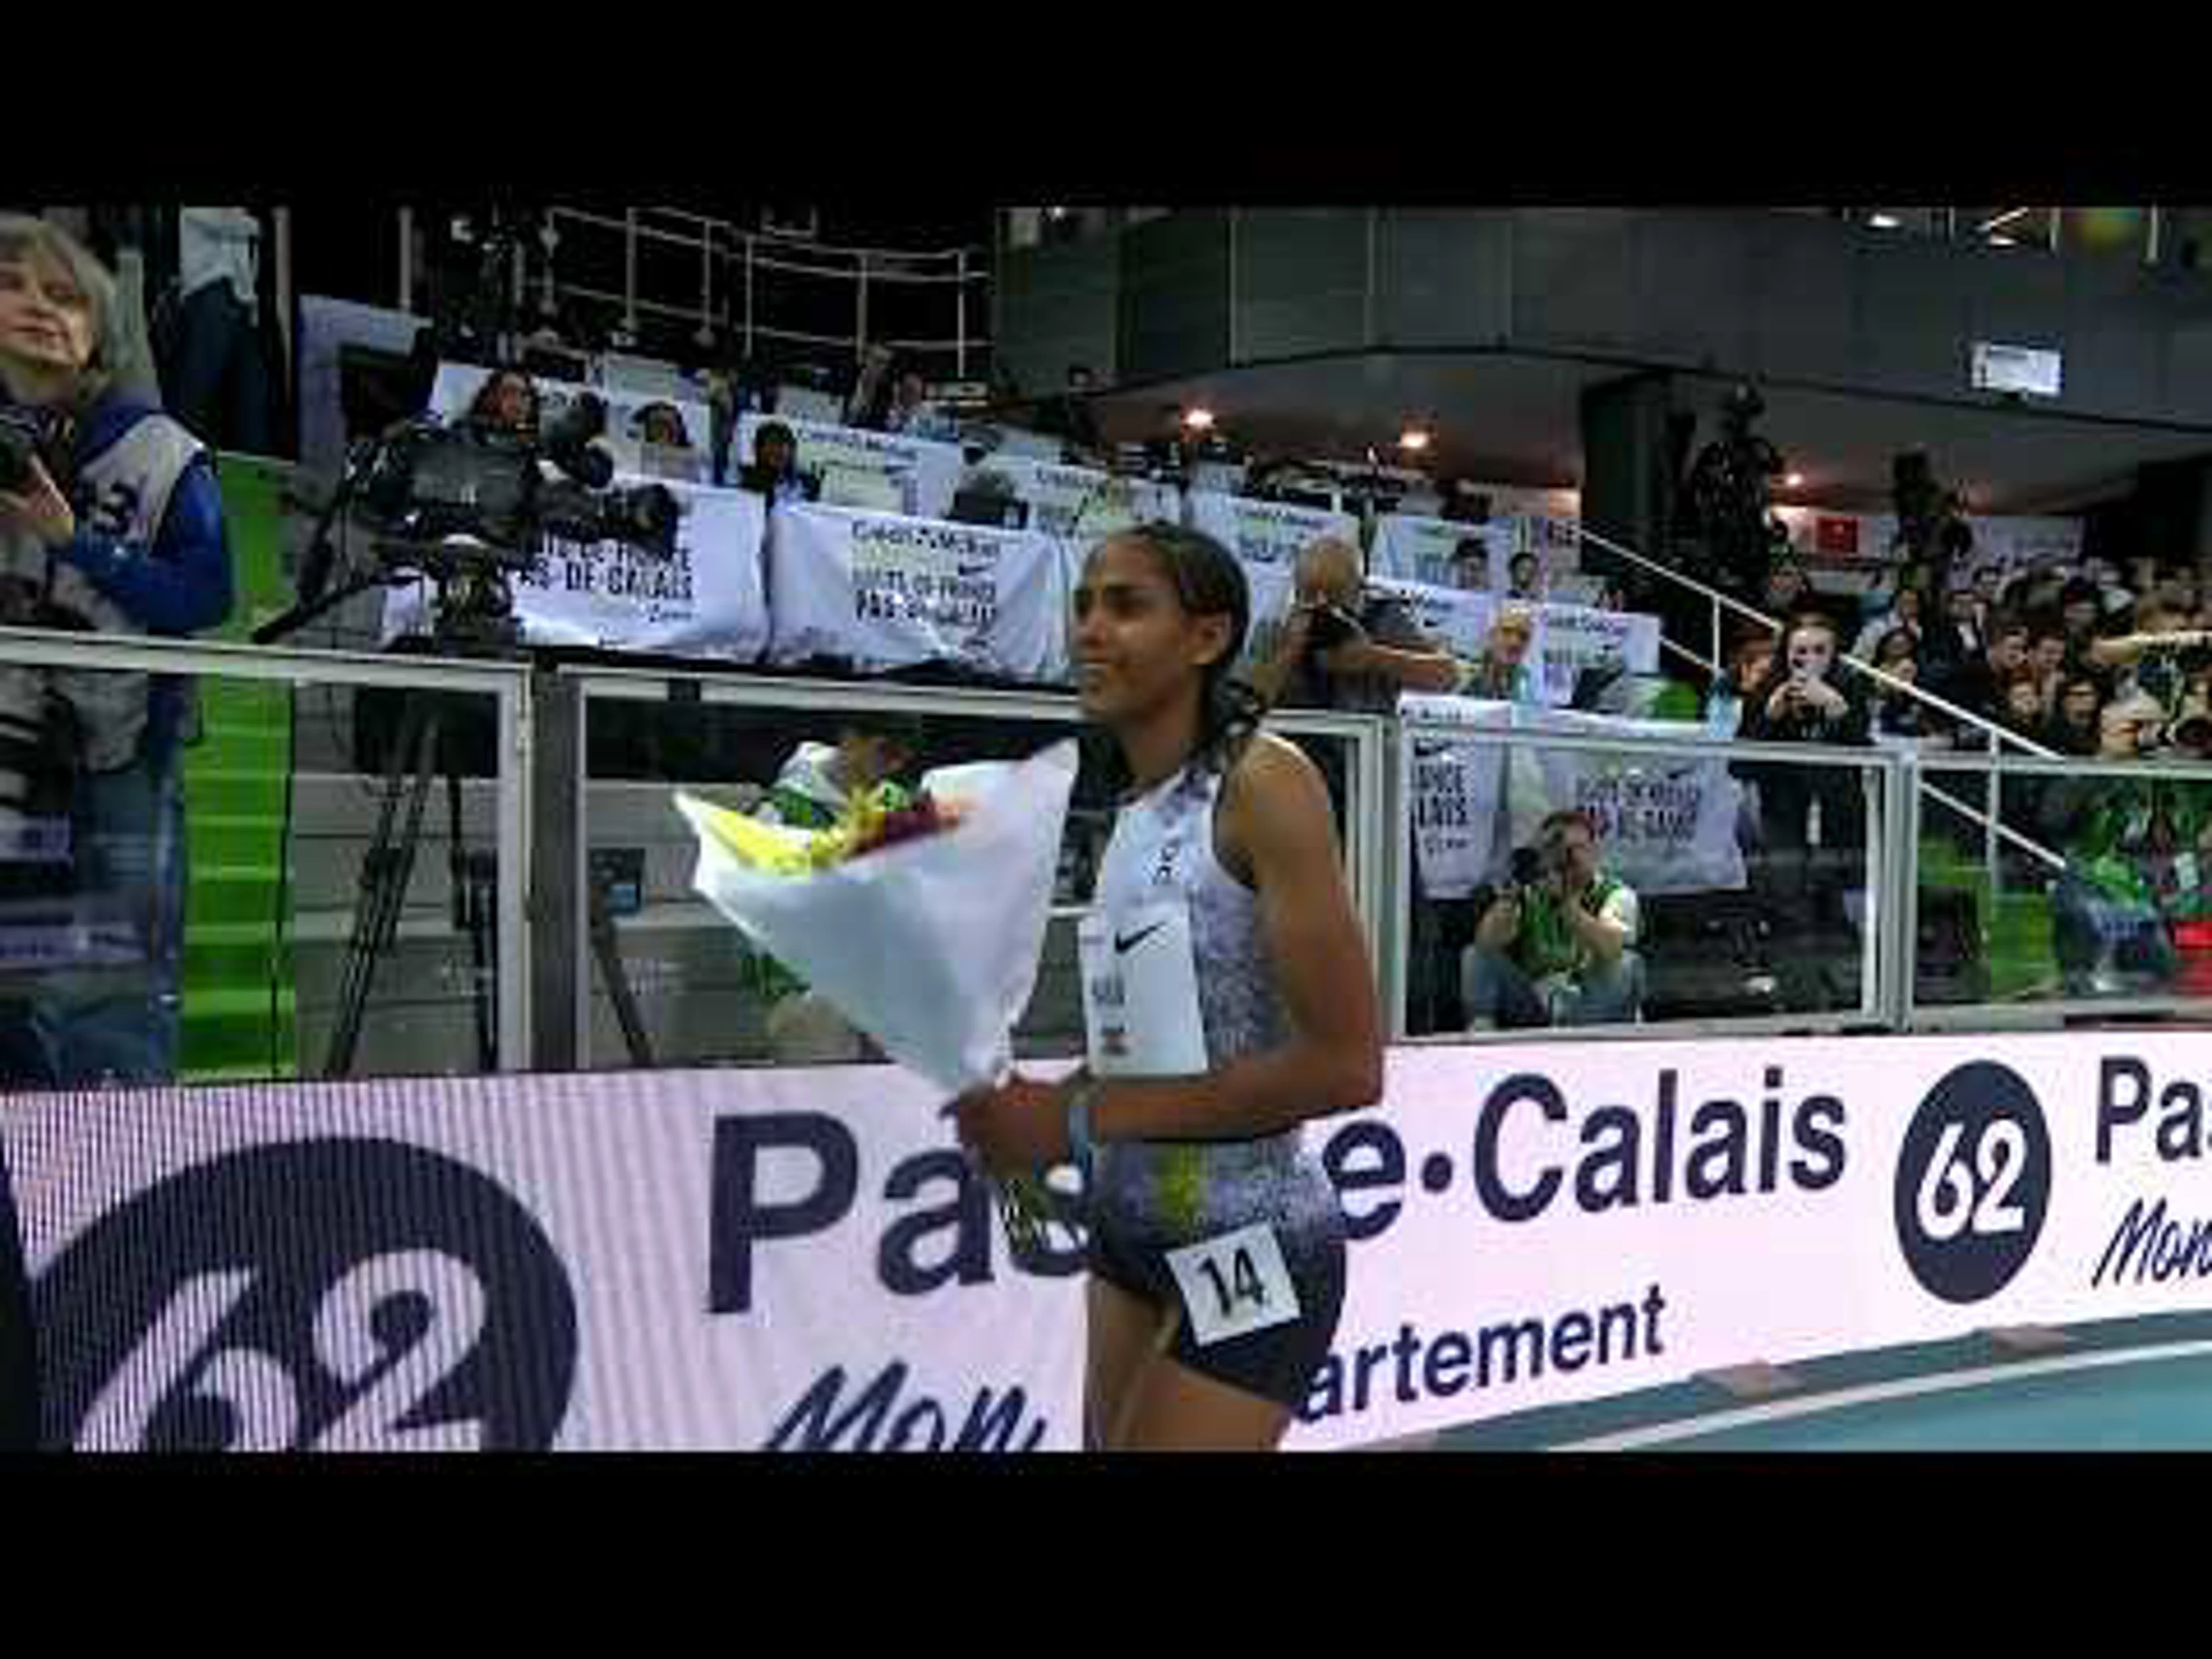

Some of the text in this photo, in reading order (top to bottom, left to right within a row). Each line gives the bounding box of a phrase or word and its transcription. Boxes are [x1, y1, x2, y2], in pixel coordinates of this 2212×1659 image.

[2095, 1055, 2212, 1165] Pa
[1916, 1118, 2028, 1241] 62
[1198, 1248, 1266, 1317] 14
